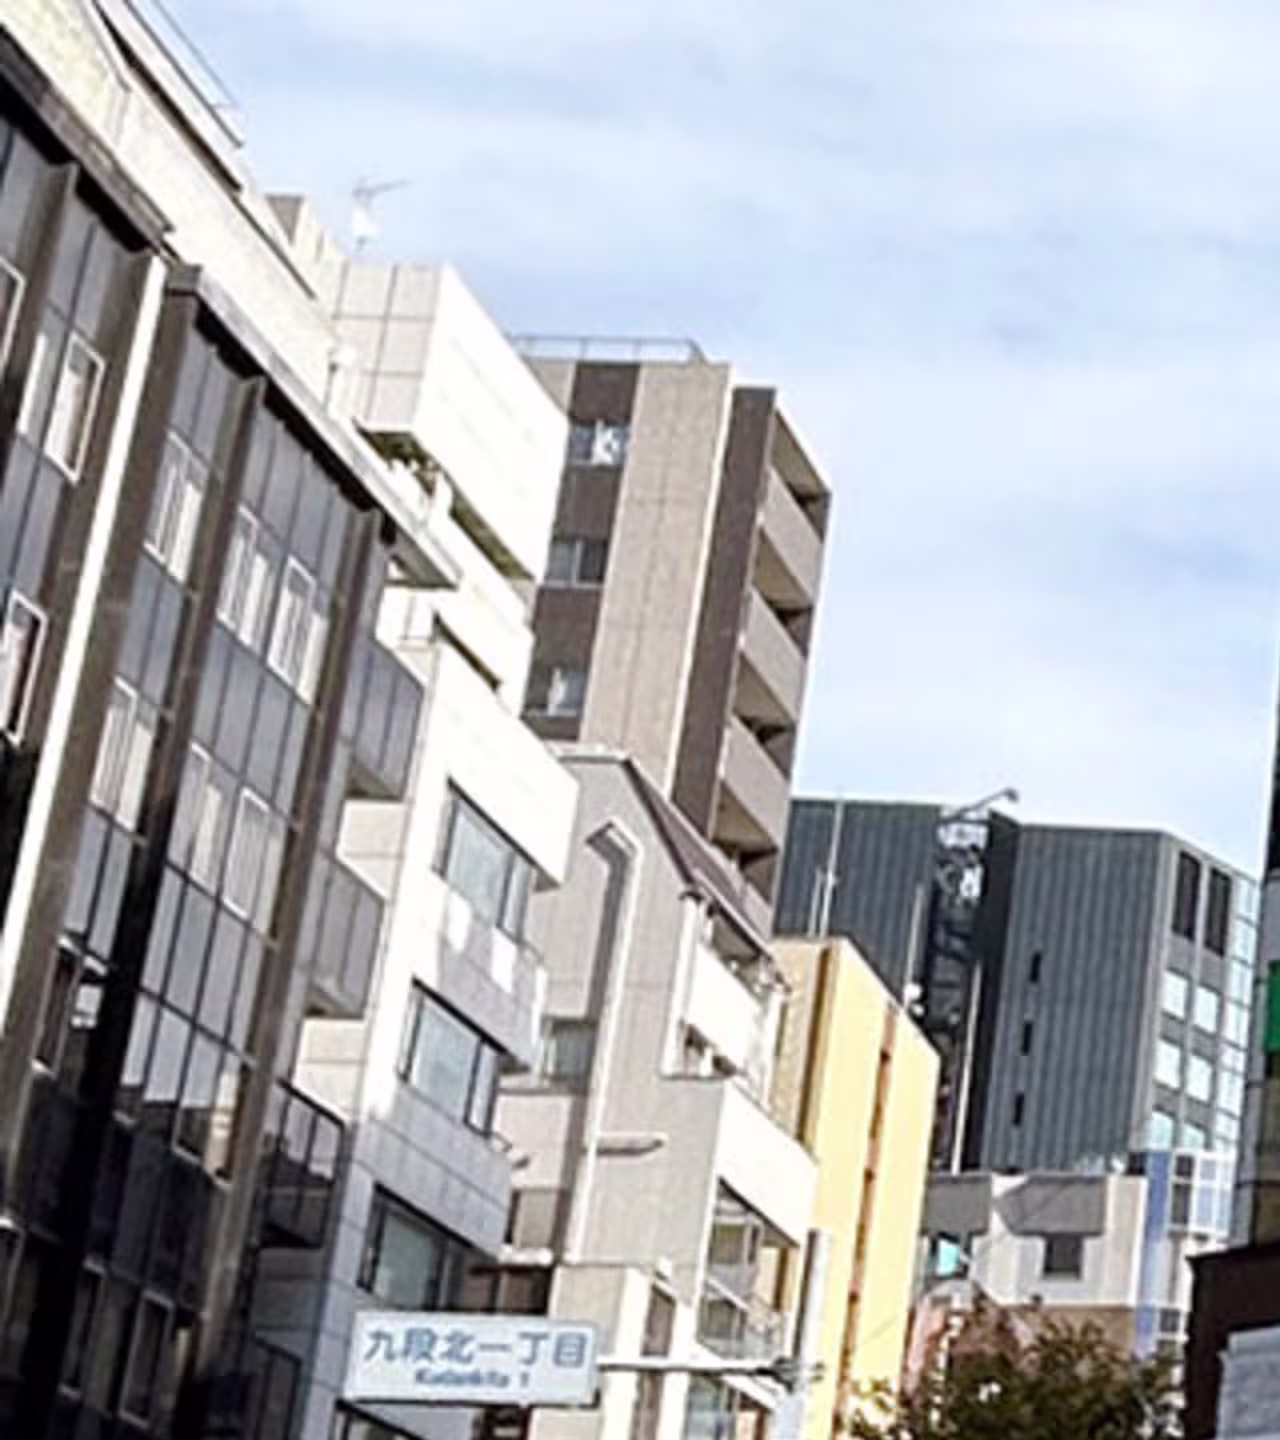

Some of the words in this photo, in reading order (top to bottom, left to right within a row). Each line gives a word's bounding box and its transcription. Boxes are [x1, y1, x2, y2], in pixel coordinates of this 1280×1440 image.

[364, 1326, 588, 1368] 九段北一丁目
